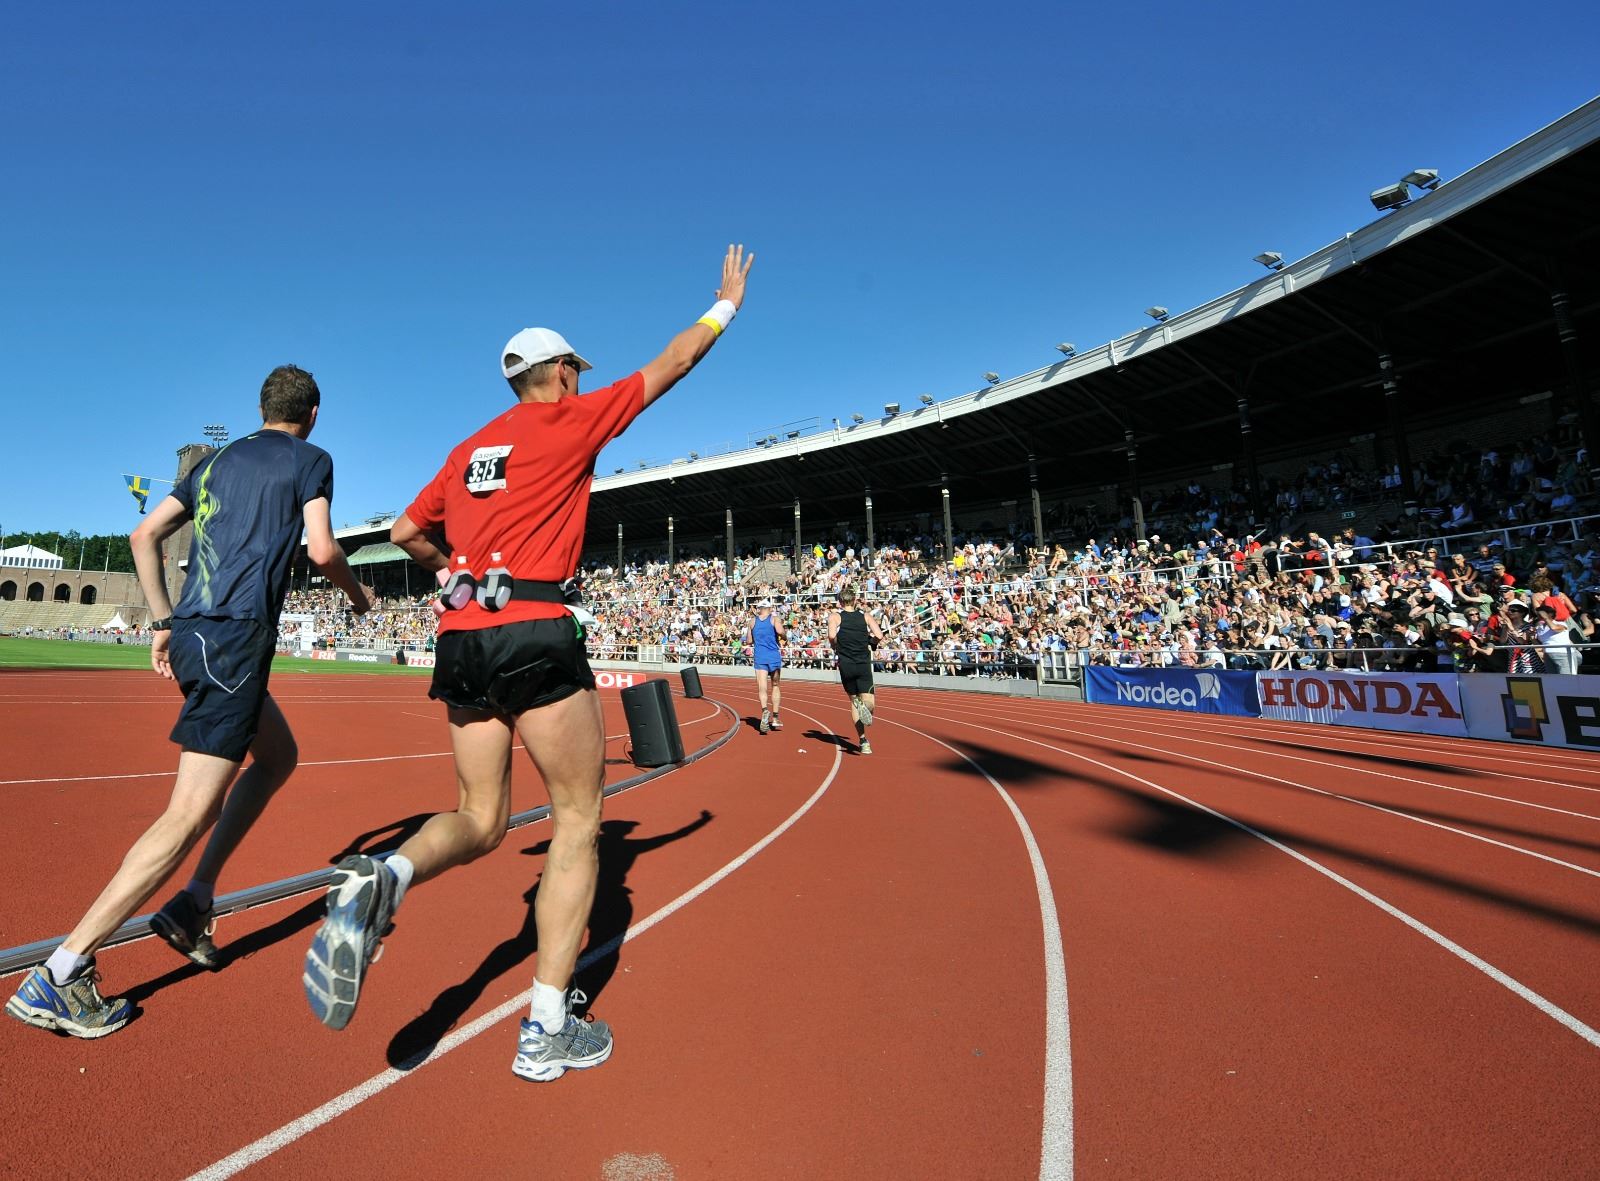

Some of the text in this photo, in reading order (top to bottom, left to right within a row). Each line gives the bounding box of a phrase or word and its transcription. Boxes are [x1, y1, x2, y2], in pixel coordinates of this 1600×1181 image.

[468, 458, 498, 483] 3:15
[348, 653, 377, 662] Reebok
[593, 673, 633, 688] OH
[1116, 681, 1197, 706] Nordea
[1260, 677, 1462, 719] HONDA
